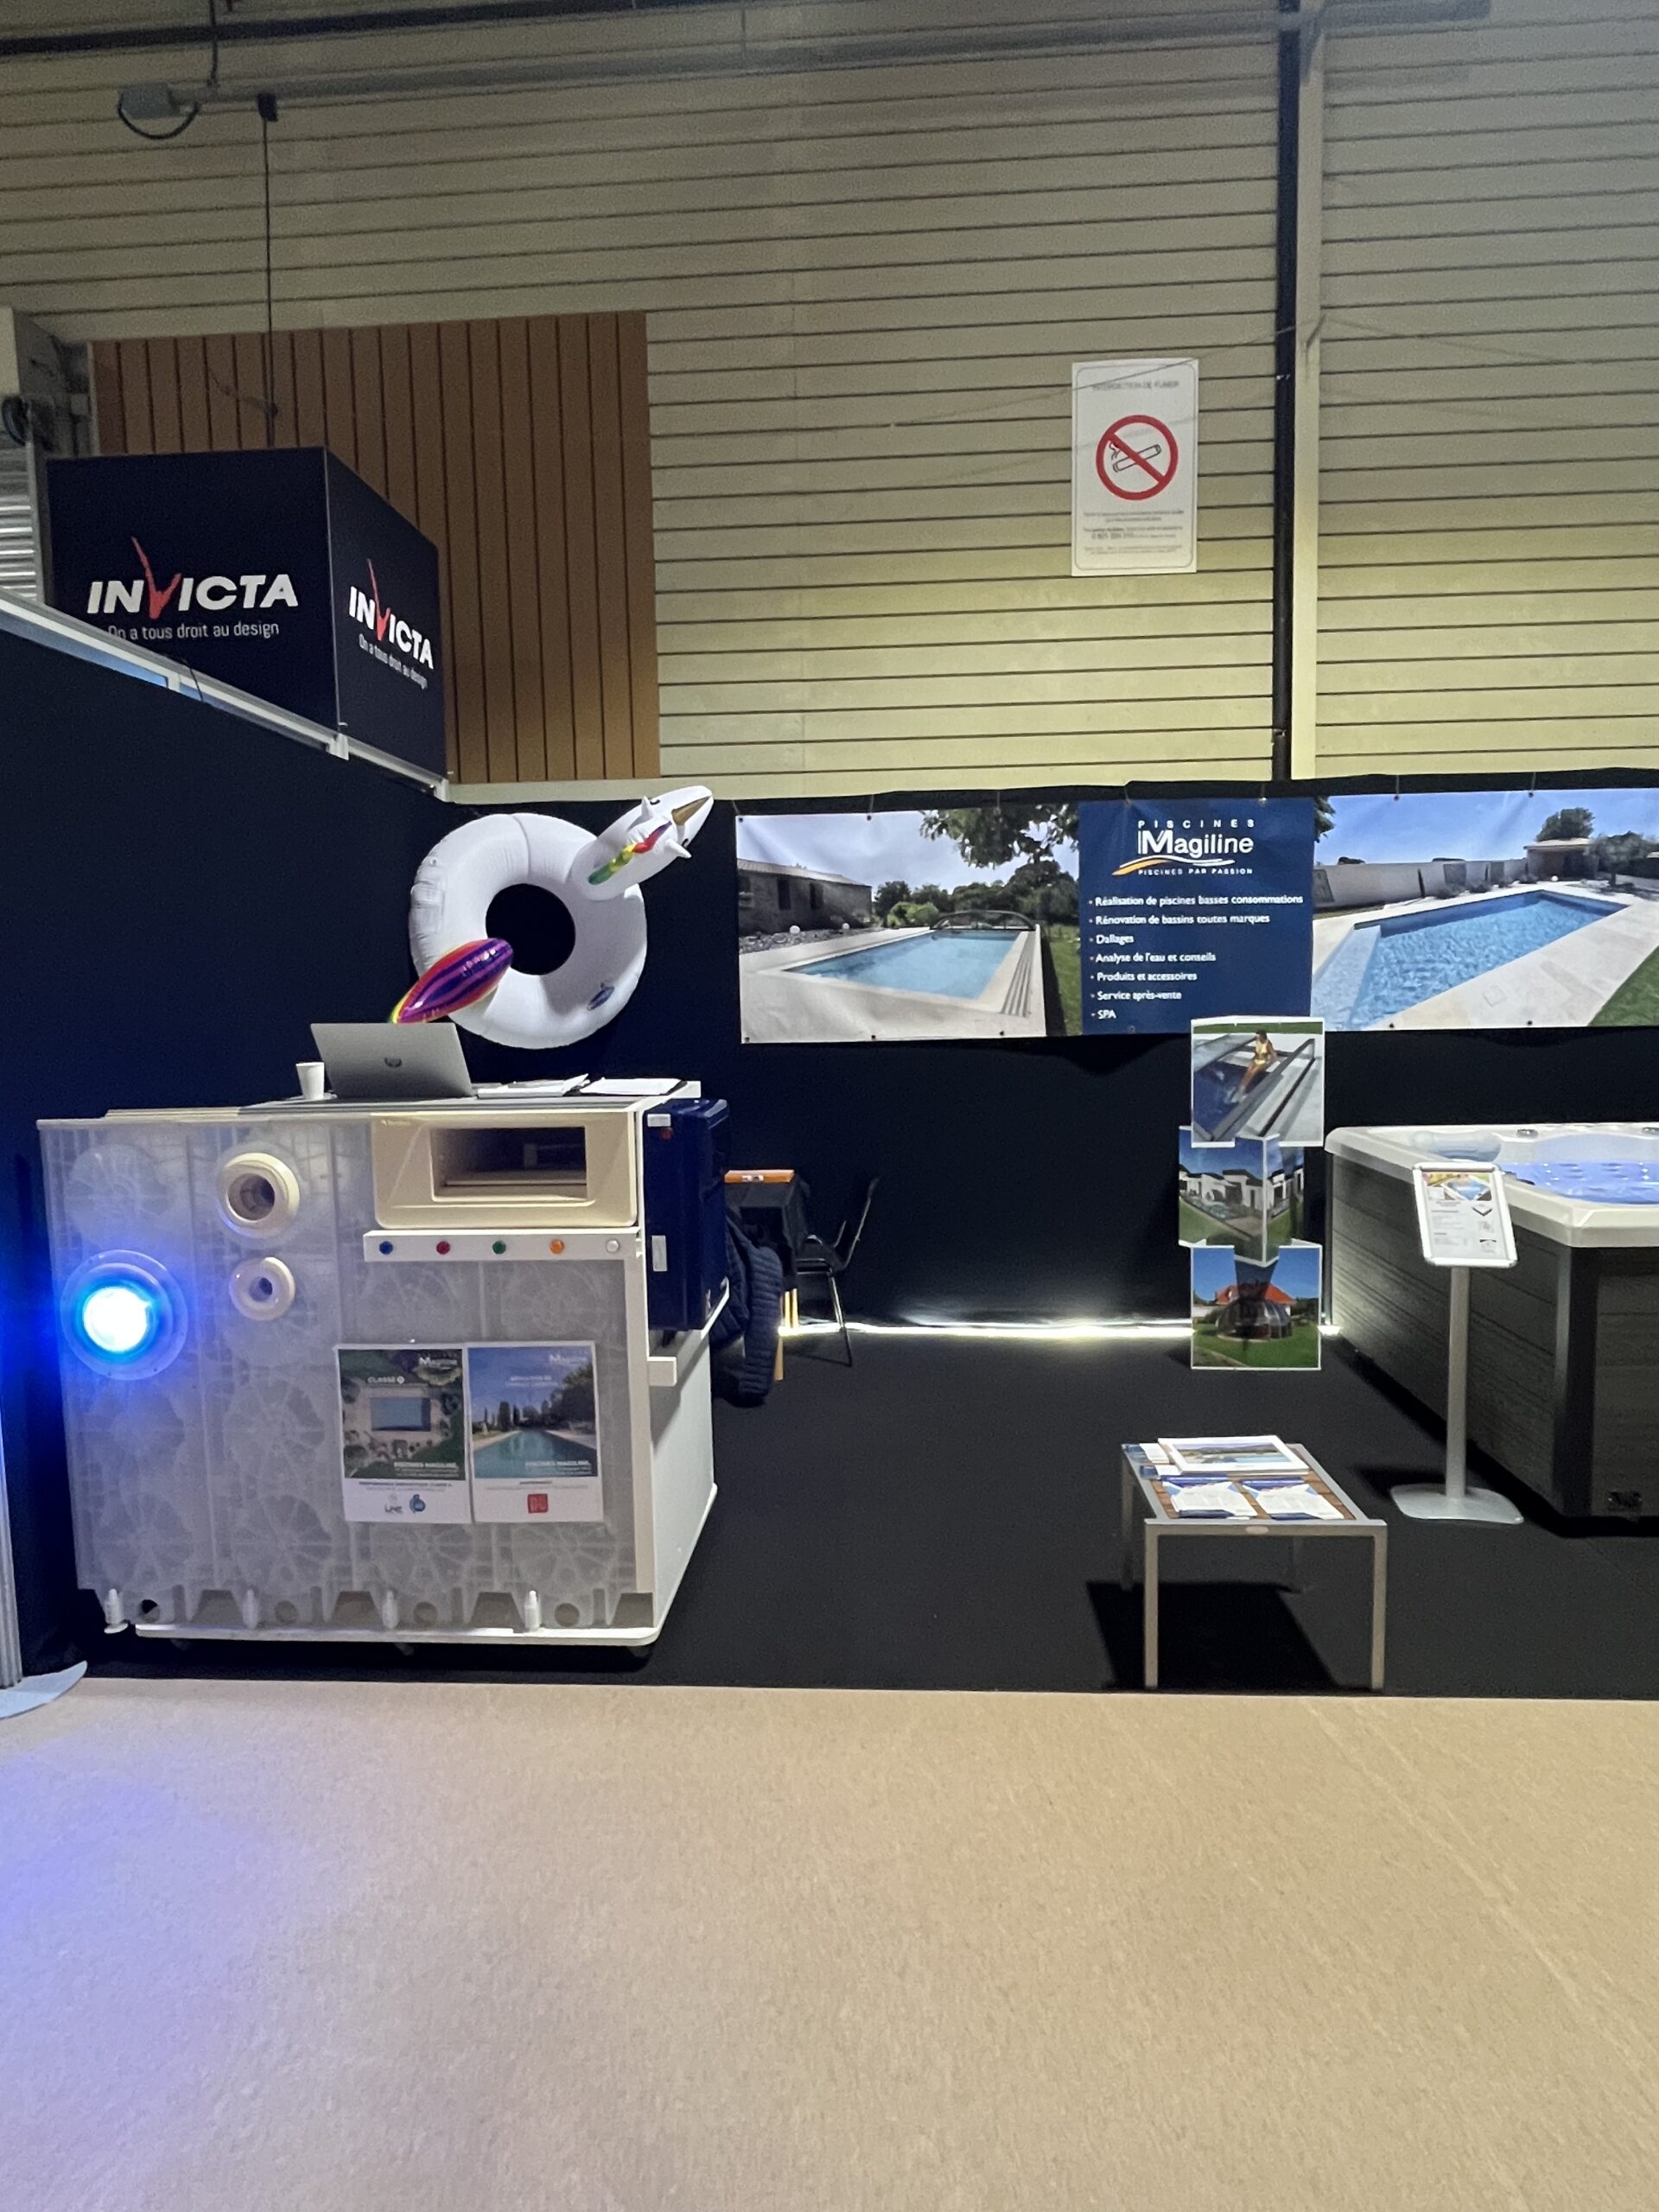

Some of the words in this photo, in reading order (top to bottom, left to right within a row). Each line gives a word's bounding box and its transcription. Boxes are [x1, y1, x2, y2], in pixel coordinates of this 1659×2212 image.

[87, 536, 299, 620] INVICTA
[348, 558, 434, 671] INVICTA
[130, 628, 138, 640] a
[143, 626, 173, 640] tous
[177, 622, 208, 639] droit
[213, 624, 229, 637] au
[234, 620, 279, 639] design
[1137, 819, 1255, 829] PISCINES
[1137, 830, 1255, 858] Magiline
[1095, 896, 1144, 906] Réalisation
[1146, 896, 1158, 906] de
[1160, 896, 1196, 907] piscines
[1198, 895, 1229, 905] basses
[1230, 894, 1304, 905] consommations
[1095, 915, 1147, 925] Rénovation
[1148, 915, 1160, 925] de
[1162, 915, 1195, 925] bassins
[1197, 915, 1228, 924] toutes
[1230, 914, 1271, 925] marques
[1096, 934, 1135, 946] Dallages
[1096, 953, 1131, 965] Analyse
[1133, 952, 1144, 962] de
[1167, 954, 1178, 963] et
[1179, 952, 1217, 962] conseils
[1096, 971, 1135, 982] Produits
[1136, 972, 1147, 982] et
[1147, 971, 1198, 982] accessoires
[1096, 990, 1131, 1001] Service
[1132, 989, 1182, 1002] après-vente
[1097, 1009, 1117, 1020] SPA
